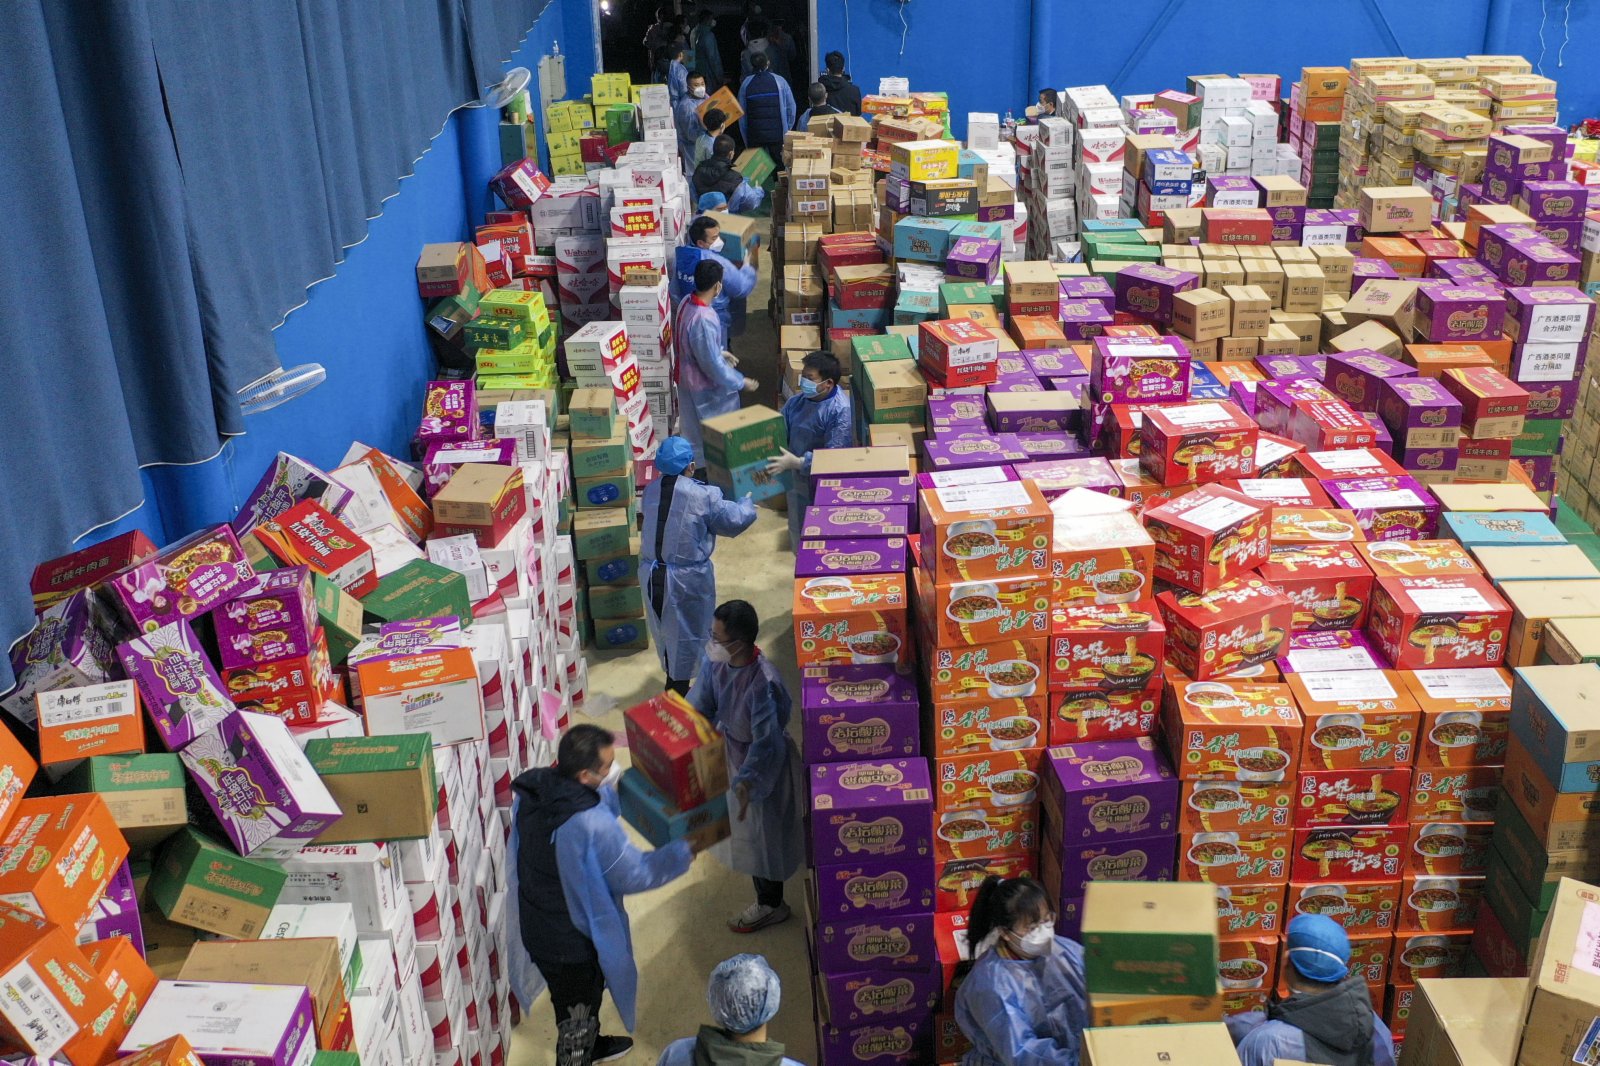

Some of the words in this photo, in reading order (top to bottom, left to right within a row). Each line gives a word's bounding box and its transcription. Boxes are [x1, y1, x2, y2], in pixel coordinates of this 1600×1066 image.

[564, 248, 598, 257] Wahaha
[568, 278, 599, 287] 娃哈哈
[1536, 314, 1582, 323] 广西酒类同盟
[1527, 353, 1571, 361] 广西酒类同盟
[1533, 362, 1562, 371] 合力捐助
[1488, 406, 1519, 414] 红烧牛肉面
[1465, 448, 1500, 456] 红烧牛肉面
[51, 557, 110, 585] 红烧牛肉面
[57, 693, 82, 706] 康师傅
[832, 725, 886, 739] 老坛酸菜
[843, 825, 898, 837] 老坛酸菜
